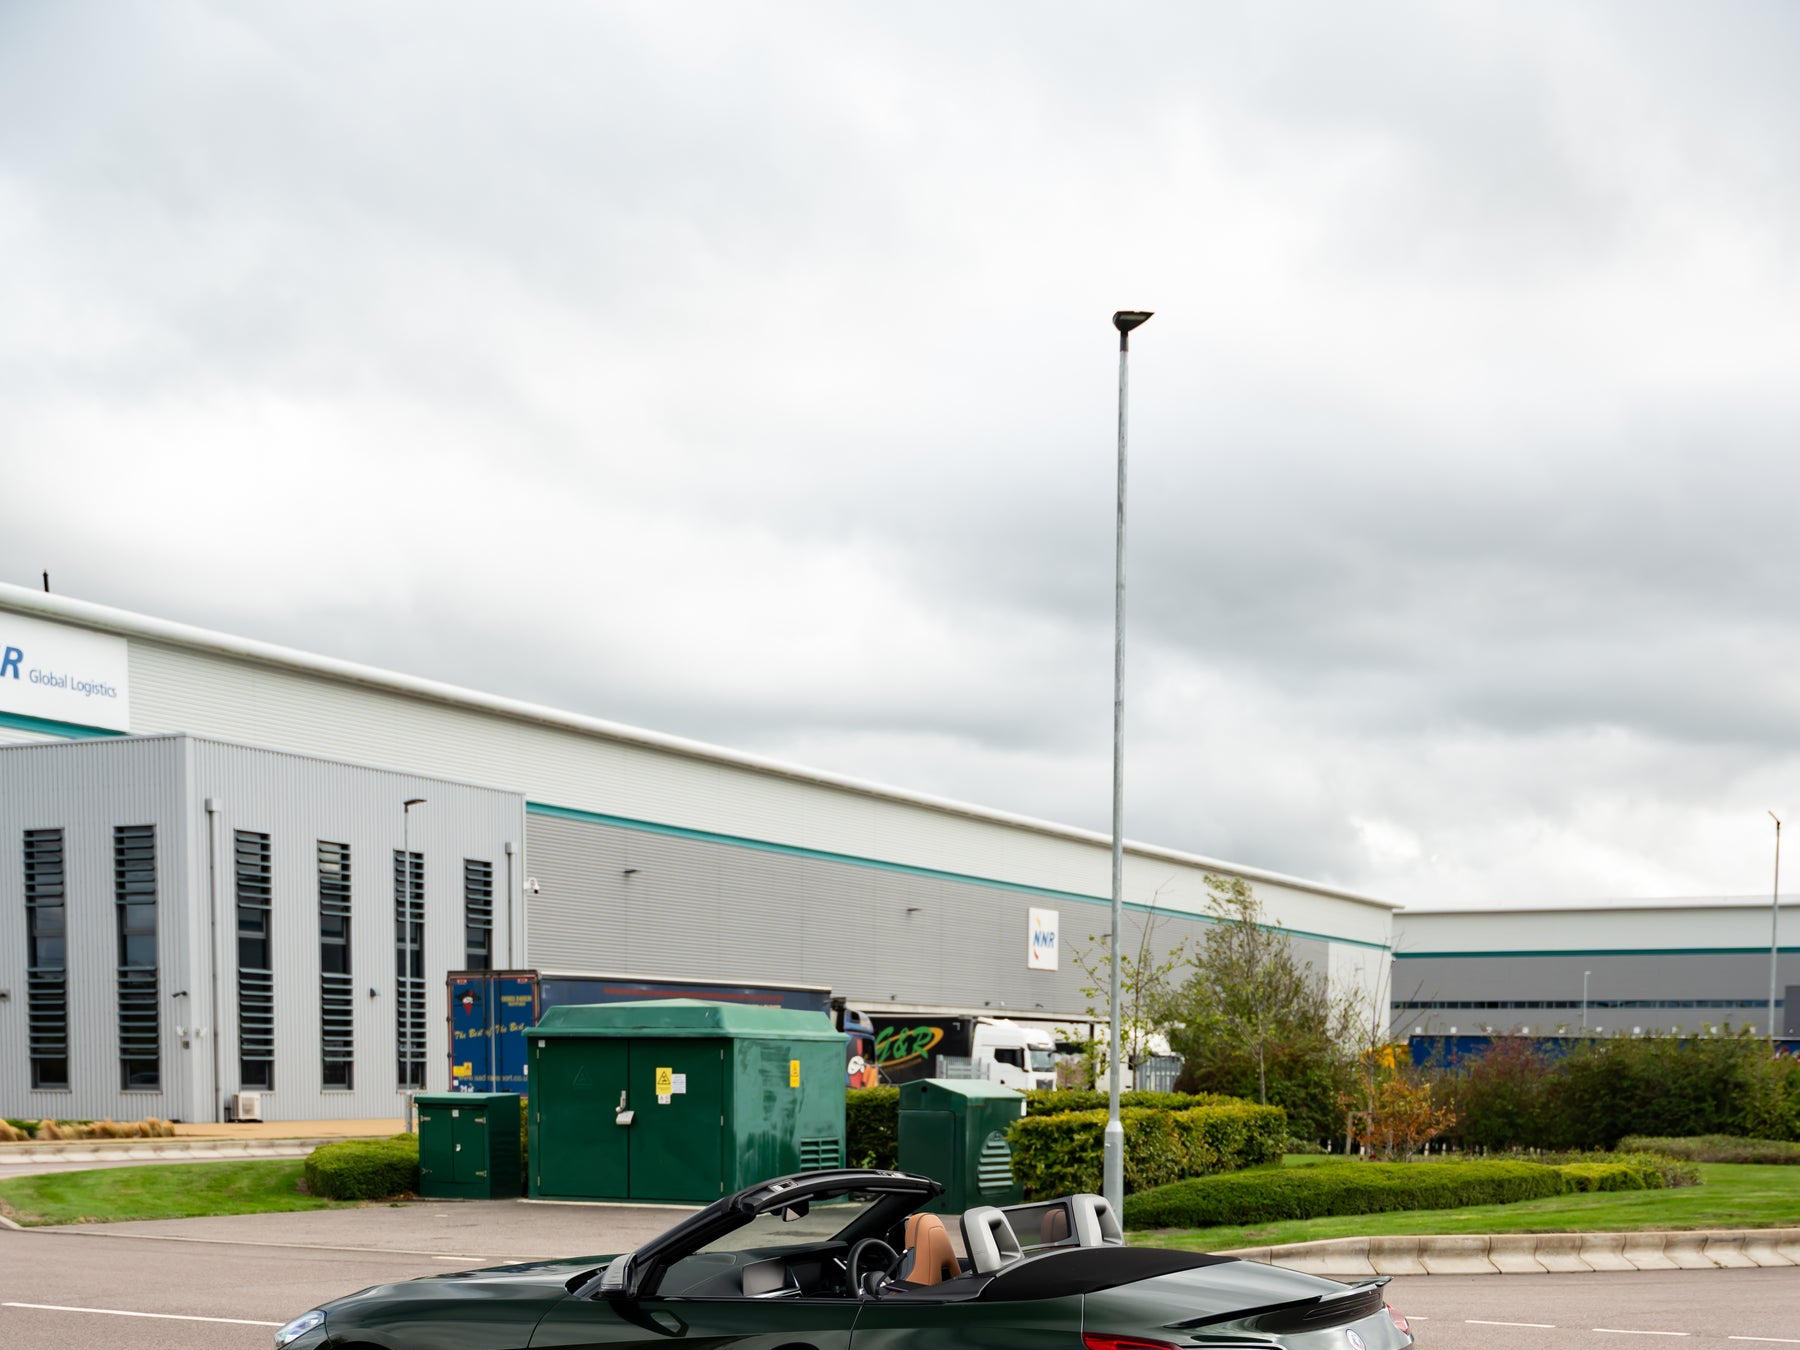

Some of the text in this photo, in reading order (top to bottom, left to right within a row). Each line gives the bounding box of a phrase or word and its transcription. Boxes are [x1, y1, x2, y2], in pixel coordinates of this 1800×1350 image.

[0, 646, 117, 698] R Global Logistics
[1033, 930, 1055, 948] NNR
